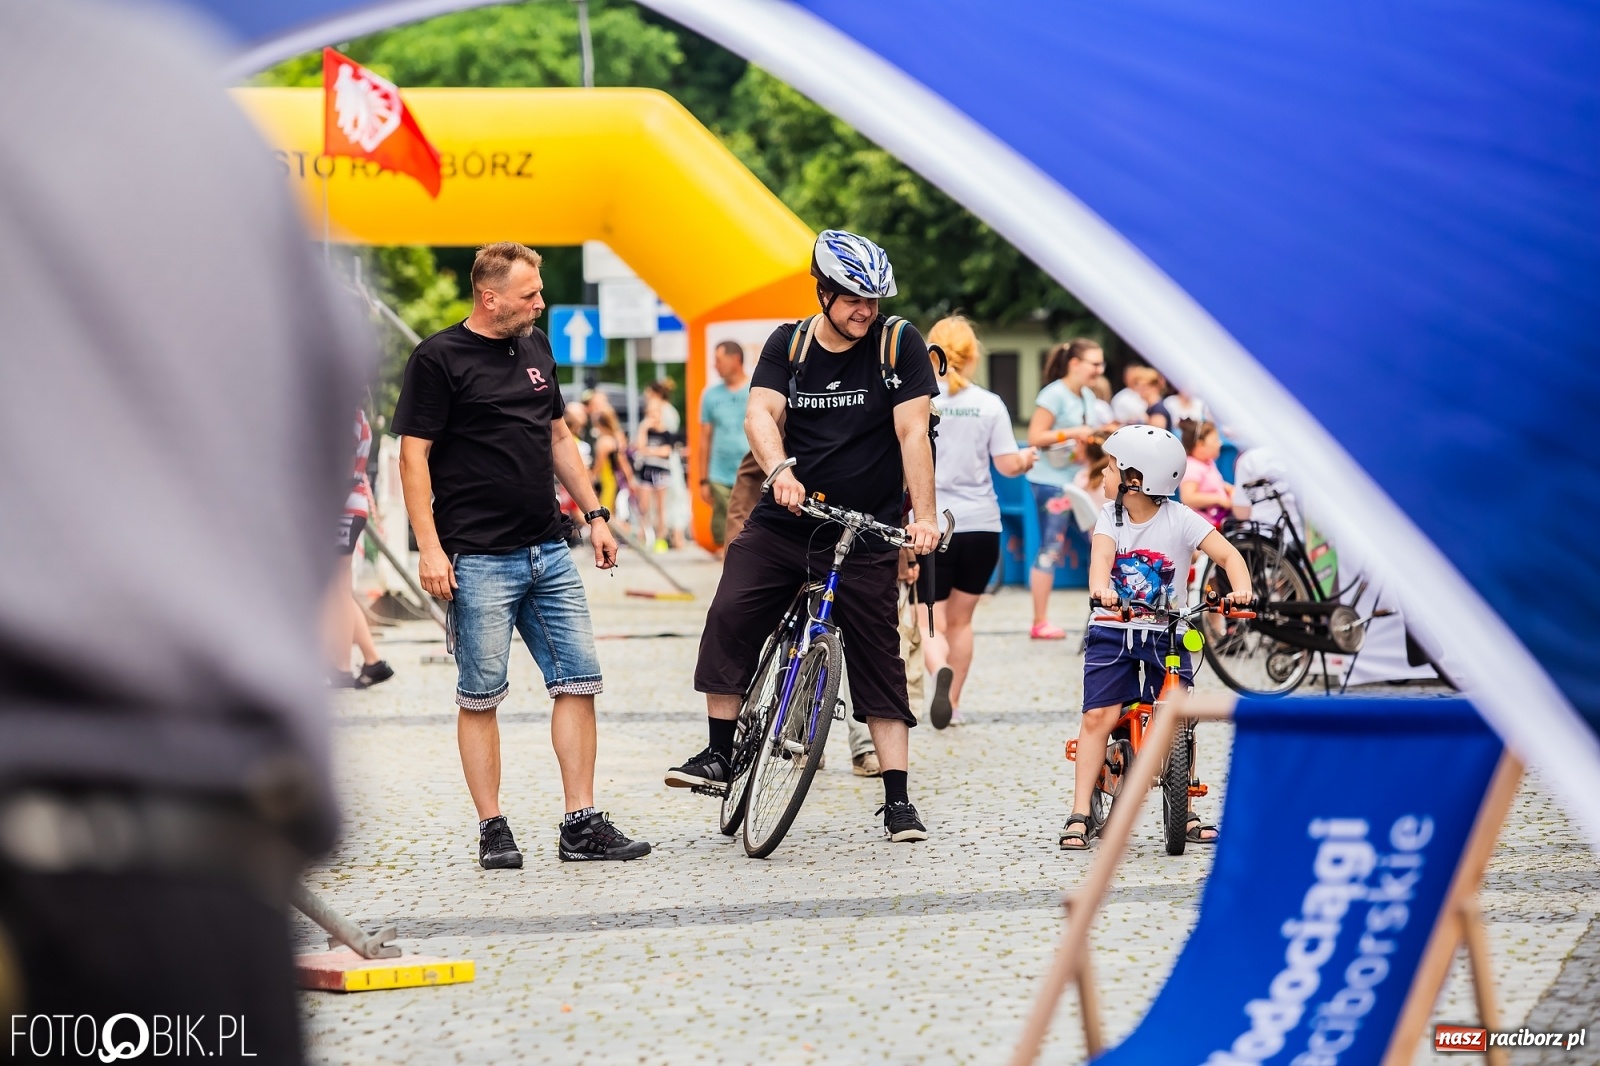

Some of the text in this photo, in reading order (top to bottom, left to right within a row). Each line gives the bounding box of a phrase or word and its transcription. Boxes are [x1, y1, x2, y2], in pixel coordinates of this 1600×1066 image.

[351, 150, 534, 179] RBÓRZ
[526, 367, 546, 385] R
[825, 381, 841, 391] 4F
[797, 393, 865, 409] SPORTSWEAR
